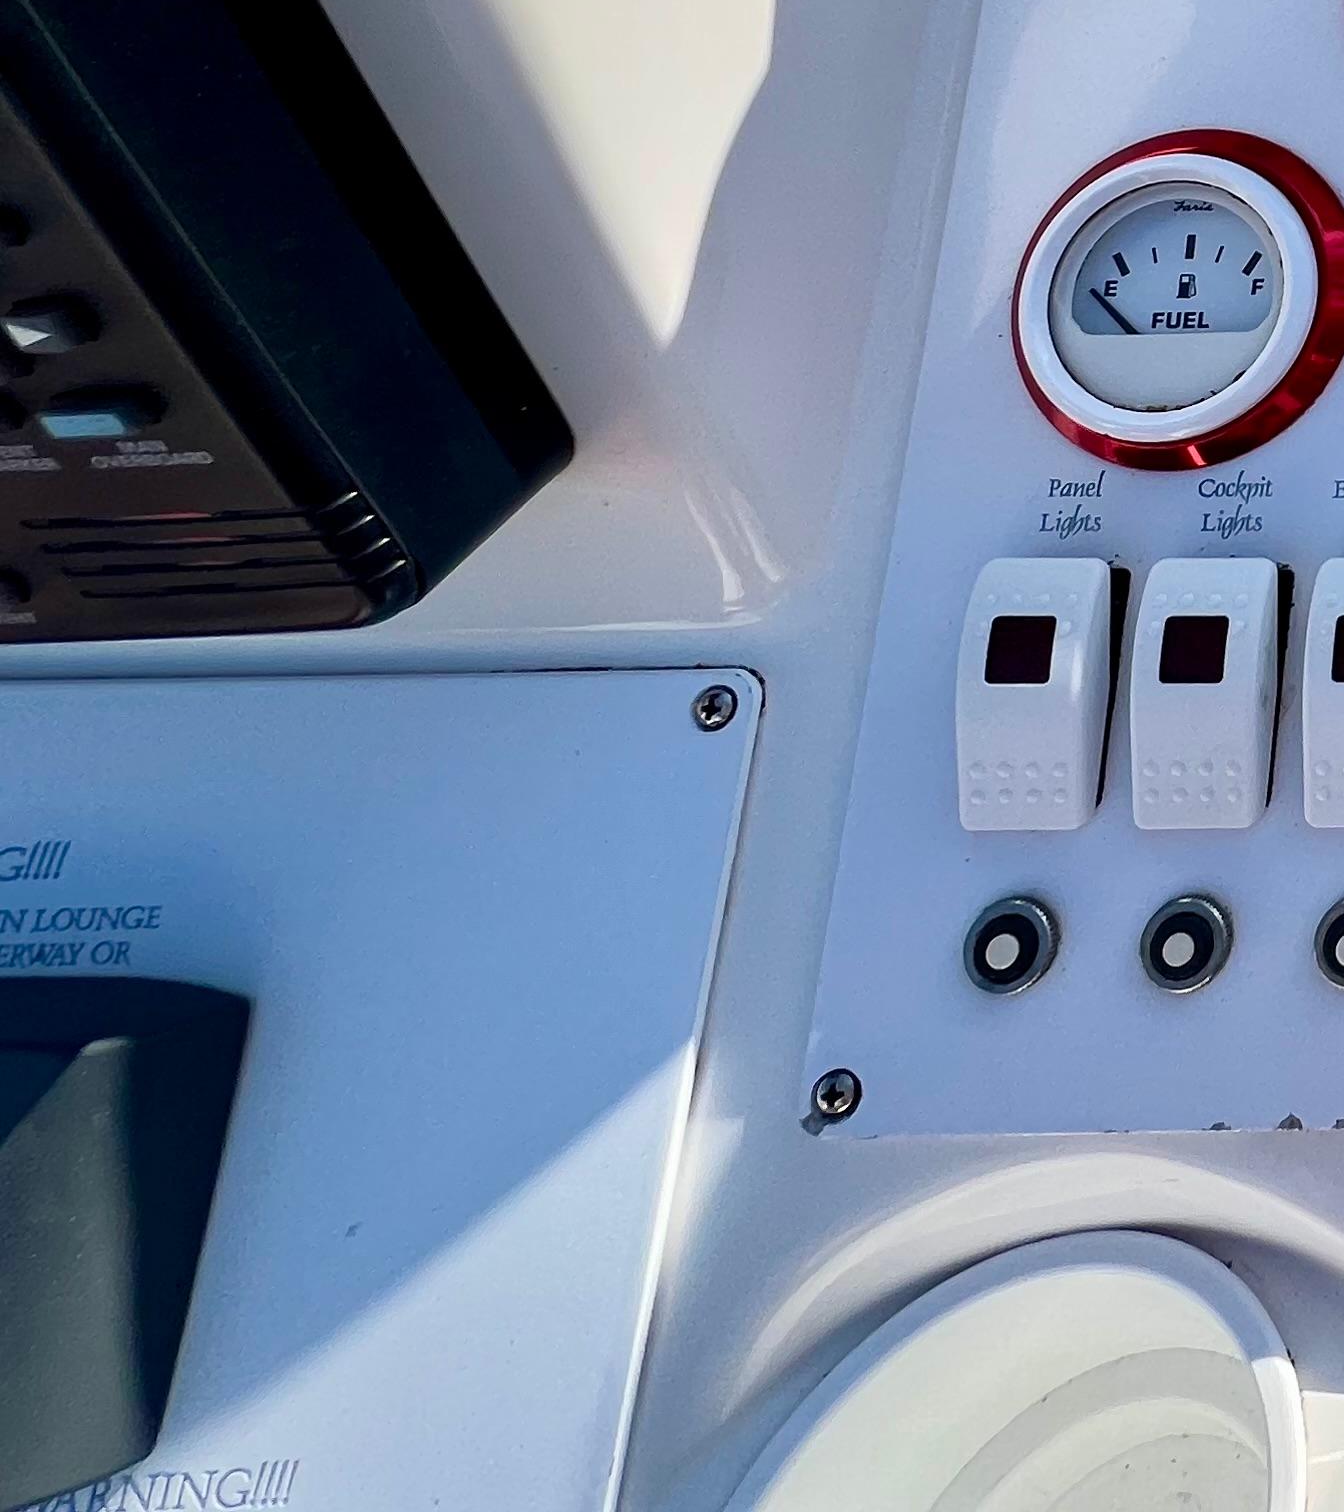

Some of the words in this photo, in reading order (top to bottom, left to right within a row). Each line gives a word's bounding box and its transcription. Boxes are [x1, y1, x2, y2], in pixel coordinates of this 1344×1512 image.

[1104, 280, 1118, 297] E
[1250, 278, 1265, 295] F
[1151, 312, 1210, 329] FUEL
[1048, 469, 1106, 498] Panel
[1198, 469, 1273, 505] Cockpit
[1039, 504, 1102, 540] Lights
[1200, 504, 1263, 540] Lights
[31, 905, 162, 932] LOUNGE
[91, 941, 131, 966] OR
